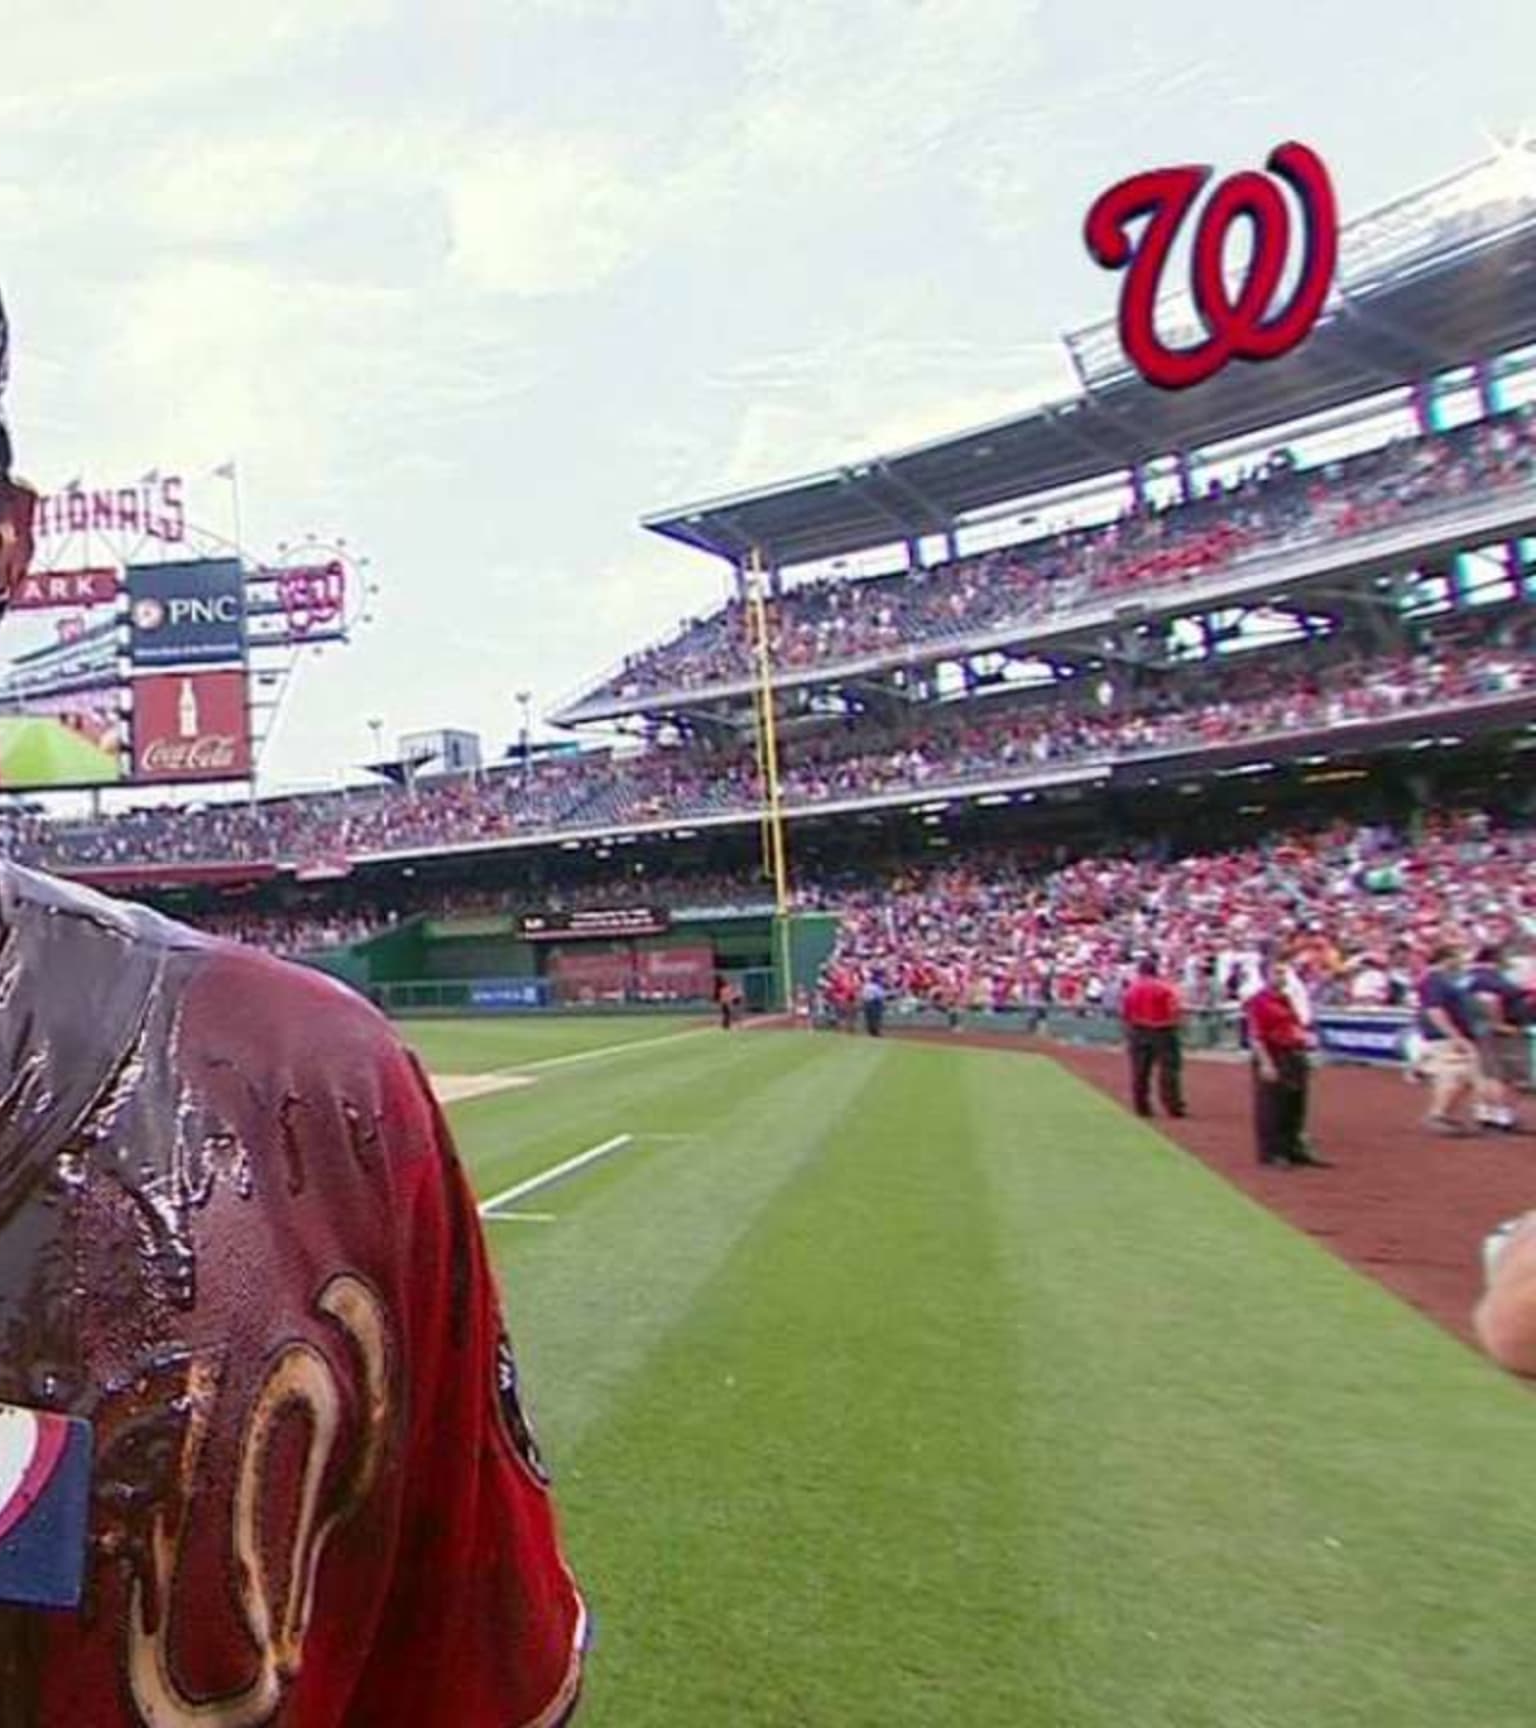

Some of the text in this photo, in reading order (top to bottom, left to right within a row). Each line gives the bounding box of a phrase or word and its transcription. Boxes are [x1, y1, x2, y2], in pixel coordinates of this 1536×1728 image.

[37, 476, 183, 542] TIONALS
[23, 575, 93, 600] ARK
[168, 595, 238, 624] PNC
